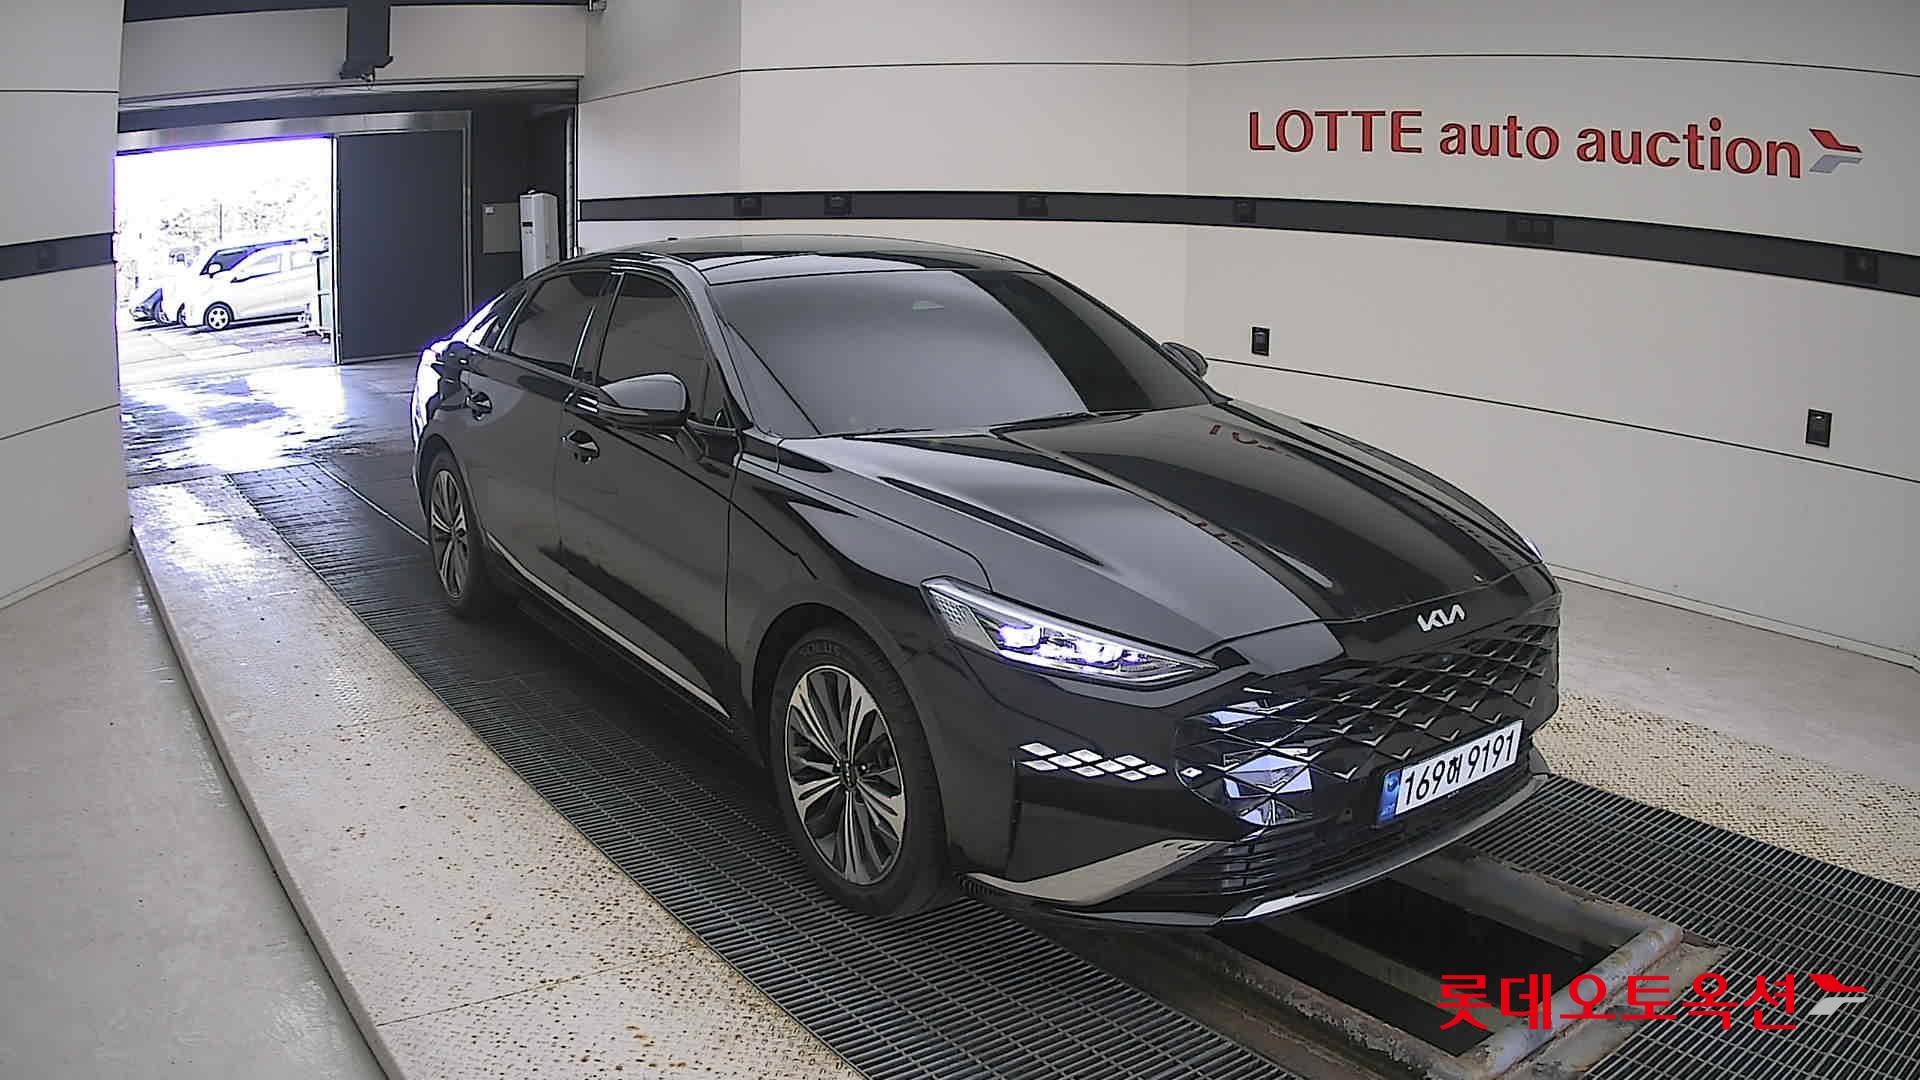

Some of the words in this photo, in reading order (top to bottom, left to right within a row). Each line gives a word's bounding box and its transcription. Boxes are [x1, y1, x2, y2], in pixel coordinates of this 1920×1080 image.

[1249, 110, 1424, 154] LOTTE
[1439, 115, 1560, 160] auto
[1576, 116, 1802, 179] auction
[1416, 604, 1465, 631] KIA
[1468, 731, 1515, 779] 9191
